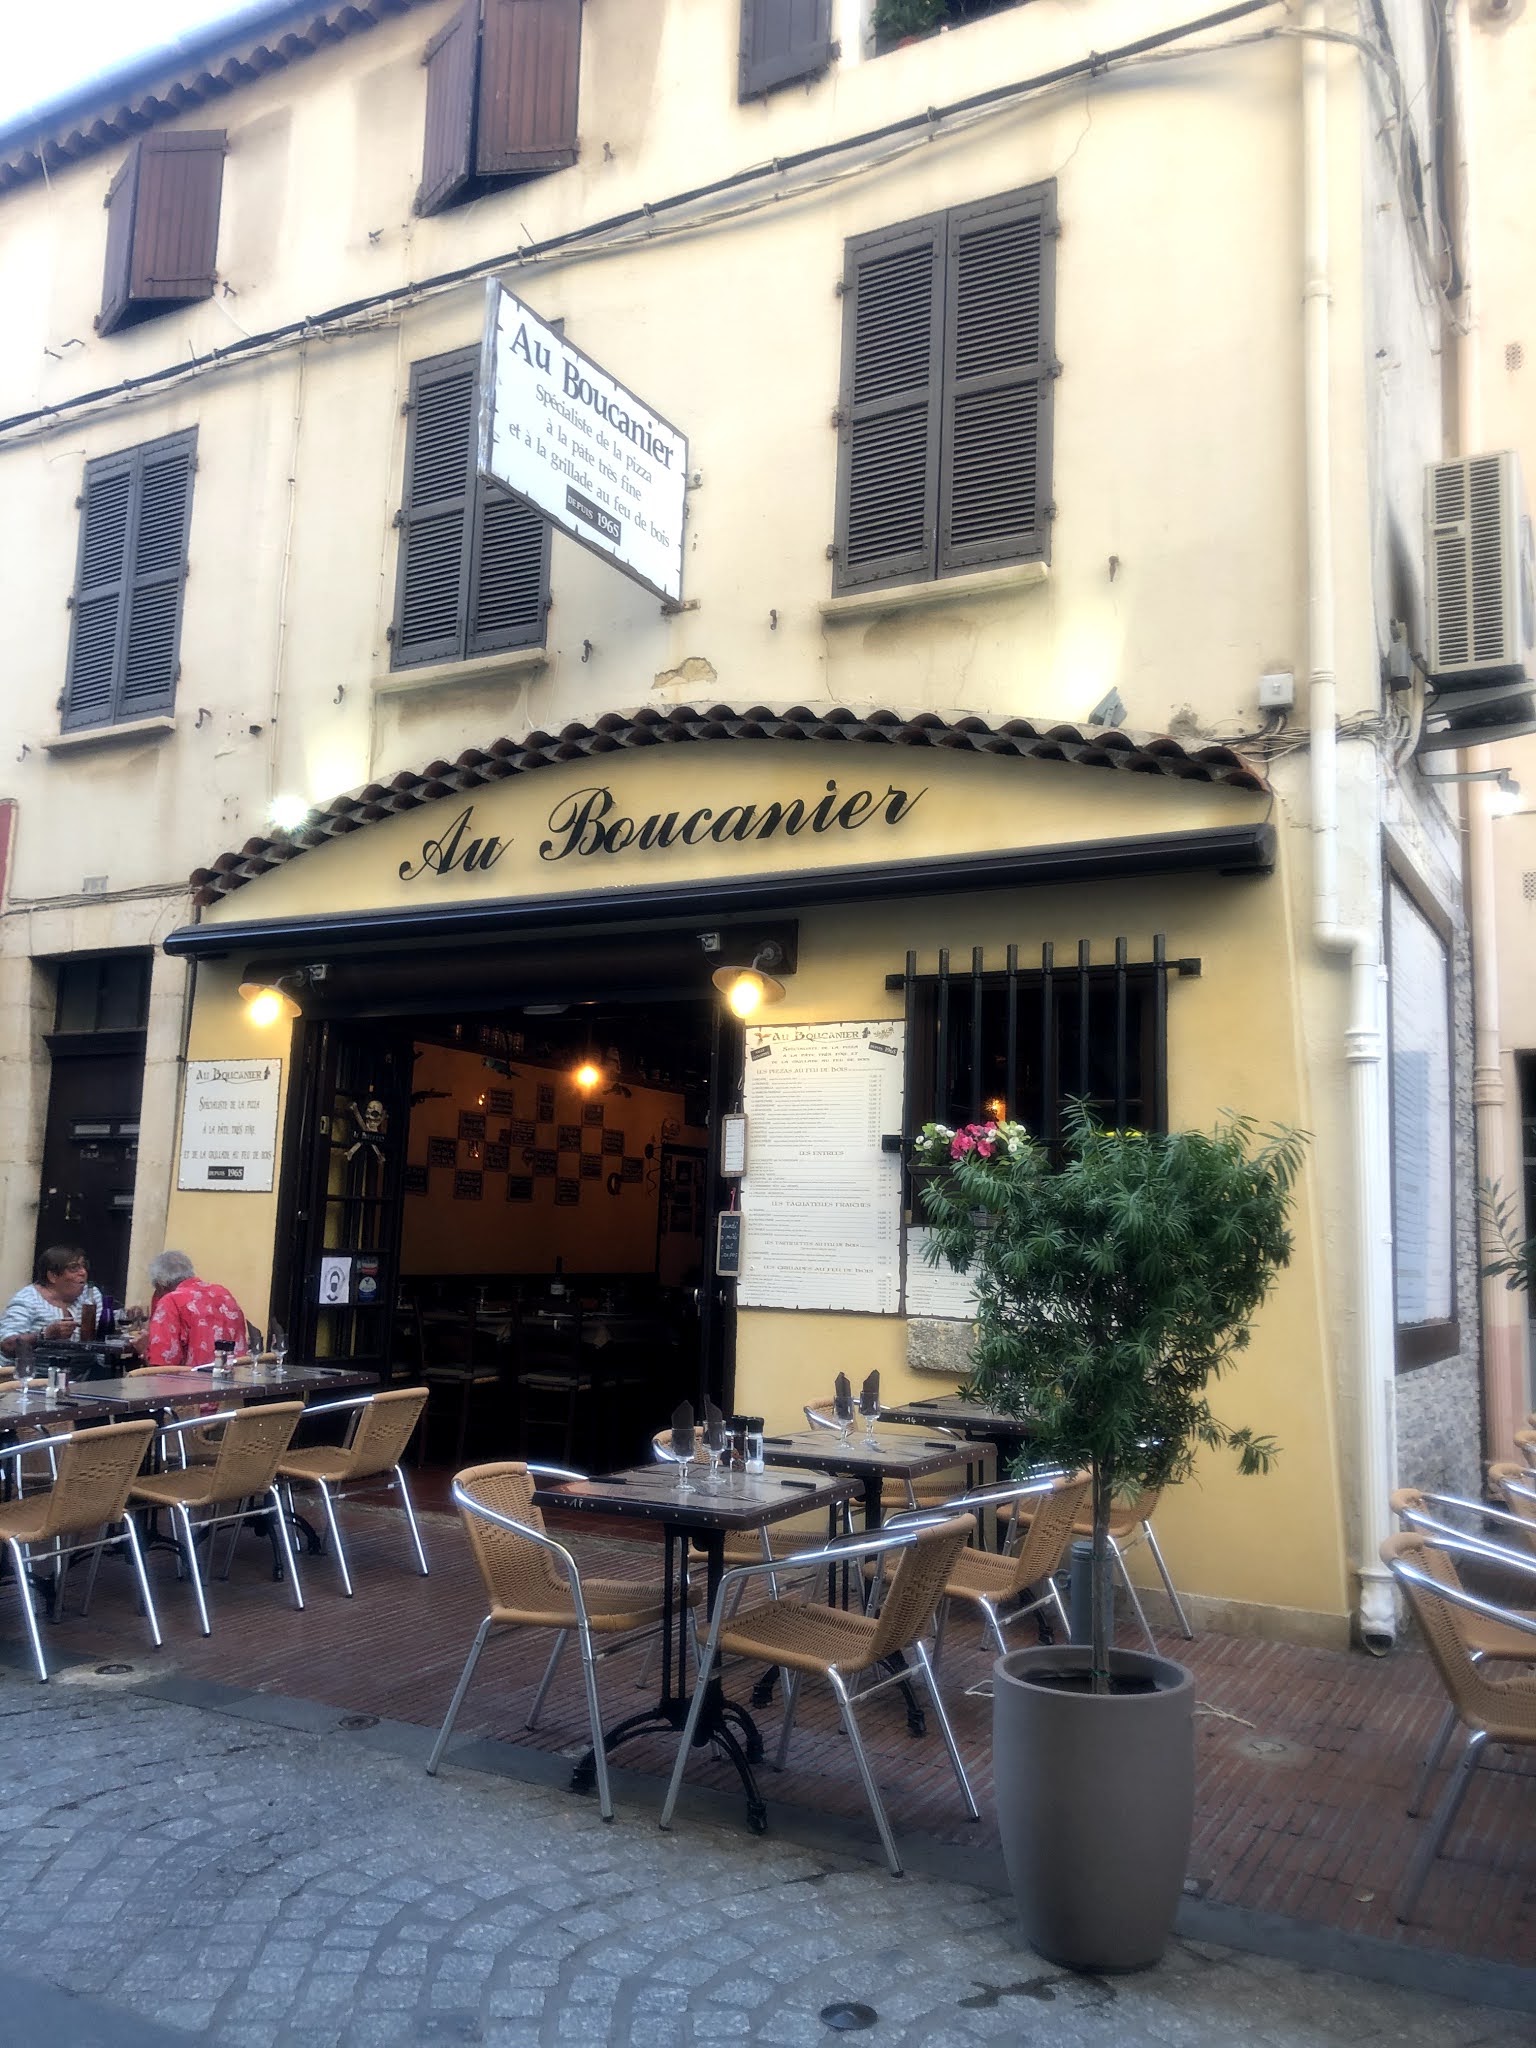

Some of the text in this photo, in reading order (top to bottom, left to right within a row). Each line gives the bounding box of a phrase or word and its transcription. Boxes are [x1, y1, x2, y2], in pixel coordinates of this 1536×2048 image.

[509, 323, 674, 470] Au Boucanier
[536, 384, 652, 484] Spécialiste de la pizza
[509, 423, 670, 547] et à la grillade au feu de bois
[546, 418, 553, 436] à
[558, 425, 567, 447] la
[599, 458, 617, 483] très
[621, 475, 641, 501] fine
[567, 495, 620, 538] DEPUIS 1965
[399, 779, 929, 881] Au Boucanier
[230, 1101, 236, 1110] DE
[238, 1101, 244, 1109] LA
[247, 1100, 260, 1109] PIZZA
[228, 1168, 243, 1177] 1965
